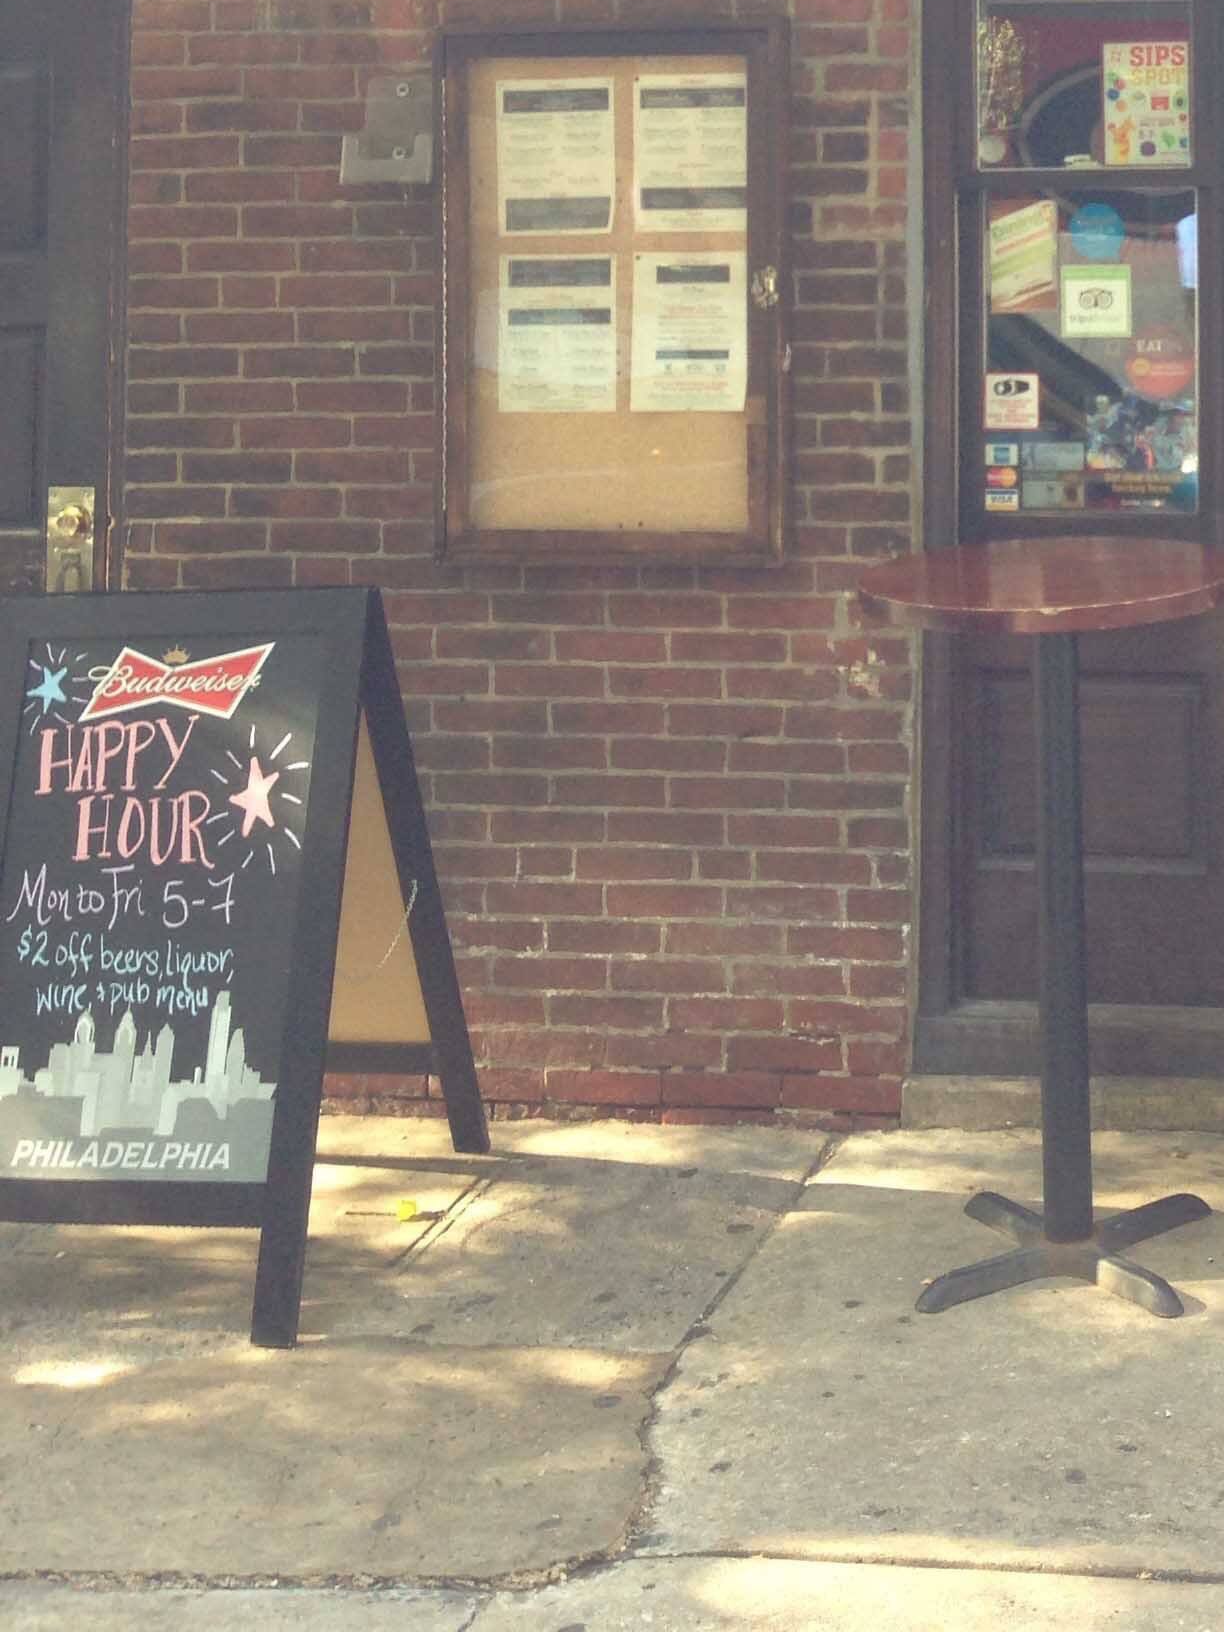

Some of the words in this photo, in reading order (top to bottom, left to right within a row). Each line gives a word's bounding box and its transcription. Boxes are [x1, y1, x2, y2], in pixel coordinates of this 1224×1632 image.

[1130, 46, 1186, 66] SIPS
[88, 665, 262, 700] Budweiser
[35, 714, 200, 796] HAPPY
[72, 789, 216, 869] HOUR
[6, 863, 73, 926] Mon
[77, 883, 105, 914] to
[100, 863, 145, 931] Fri
[162, 871, 236, 928] 5-7
[17, 923, 50, 967] $2
[55, 931, 93, 978] off
[109, 976, 150, 1016] pub
[156, 985, 210, 1017] menu
[10, 1138, 231, 1169] PHILADELPHIA
